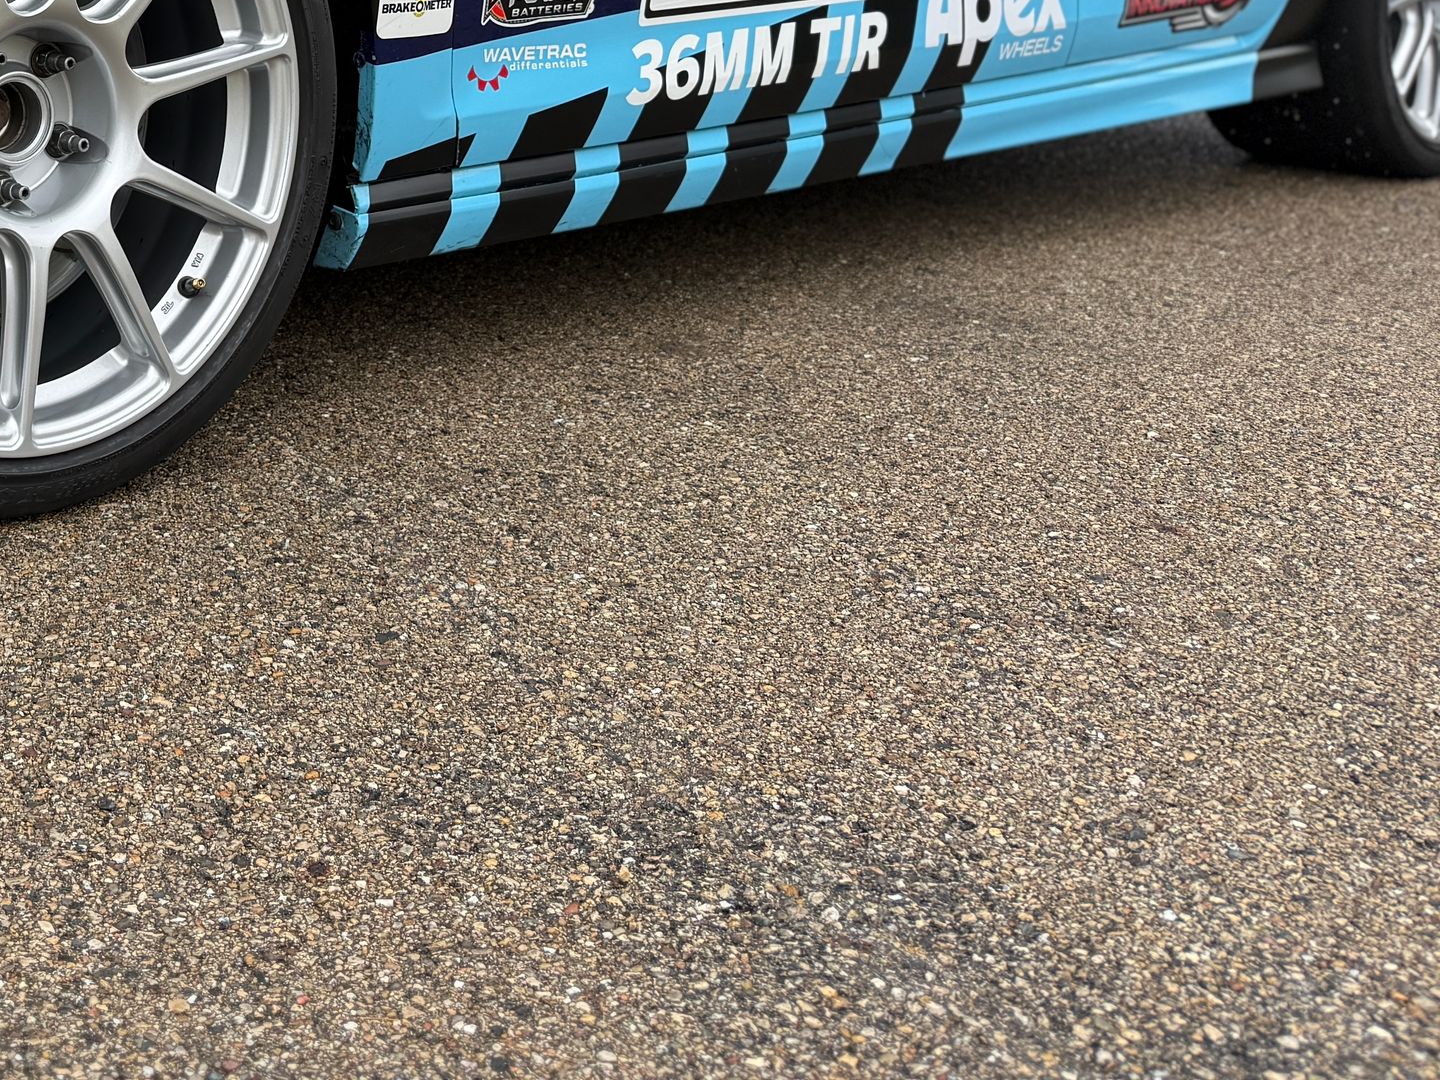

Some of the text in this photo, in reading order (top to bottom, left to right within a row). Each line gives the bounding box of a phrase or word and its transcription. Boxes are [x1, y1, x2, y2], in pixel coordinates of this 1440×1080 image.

[511, 3, 584, 18] BATTERIES
[483, 43, 588, 63] WAVETRAC
[998, 35, 1065, 61] WHEELS
[509, 58, 589, 71] differentials
[625, 11, 889, 106] 36MM TIR
